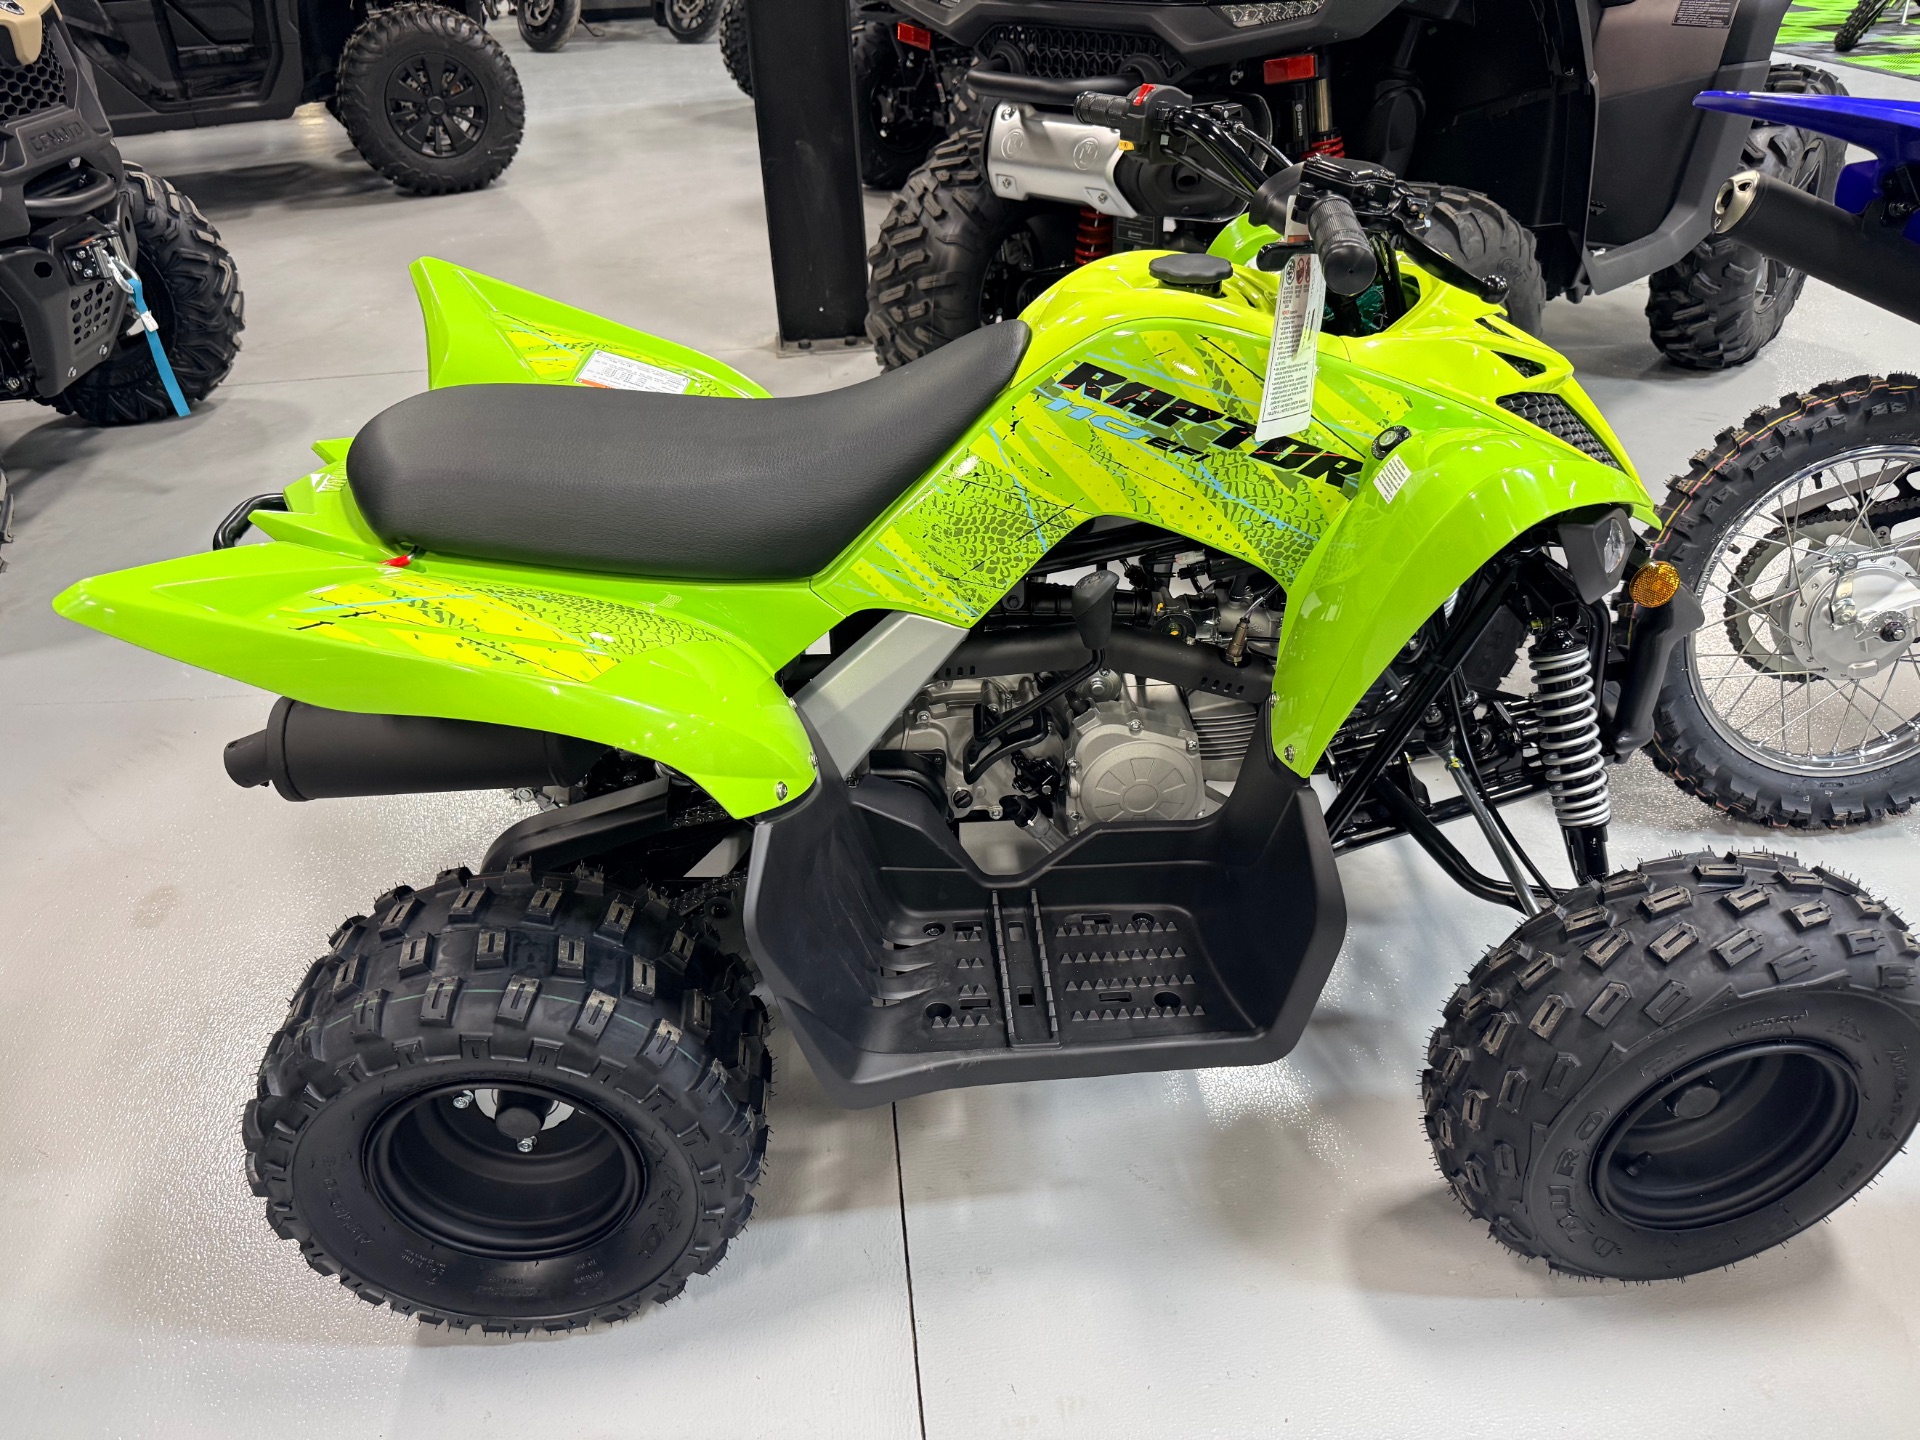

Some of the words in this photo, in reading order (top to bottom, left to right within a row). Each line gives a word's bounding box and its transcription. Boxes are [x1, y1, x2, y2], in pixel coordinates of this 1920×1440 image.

[1043, 397, 1156, 440] 110
[1052, 361, 1363, 488] RAPTOR
[1145, 436, 1212, 462] EFI
